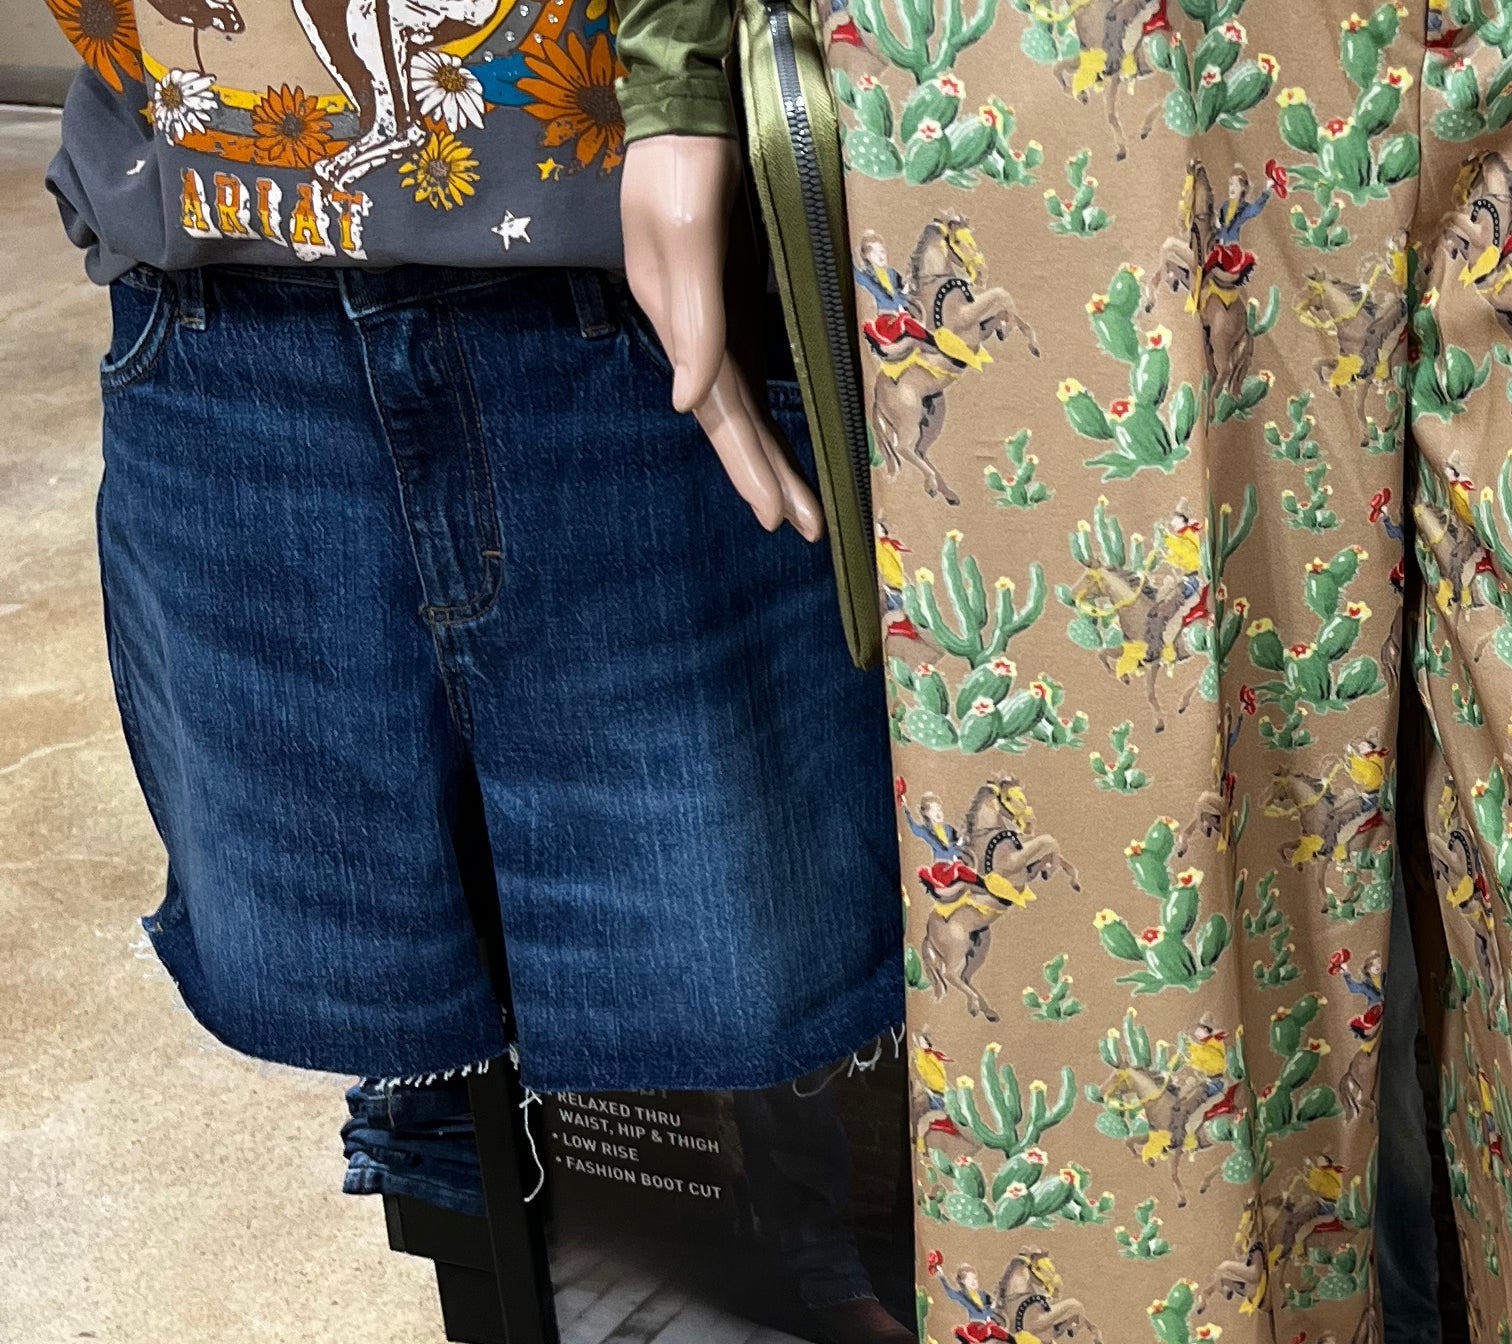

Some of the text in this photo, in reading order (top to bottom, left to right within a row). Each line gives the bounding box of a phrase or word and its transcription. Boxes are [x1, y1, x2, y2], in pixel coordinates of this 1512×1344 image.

[180, 167, 373, 262] ARIAT
[557, 1090, 631, 1119] RELAXED
[634, 1106, 682, 1128] THRU
[558, 1107, 720, 1155] WAIST, HIP & THIGH
[562, 1131, 640, 1163] LOW RISE
[566, 1155, 722, 1200] FASHION BOOT CUT
